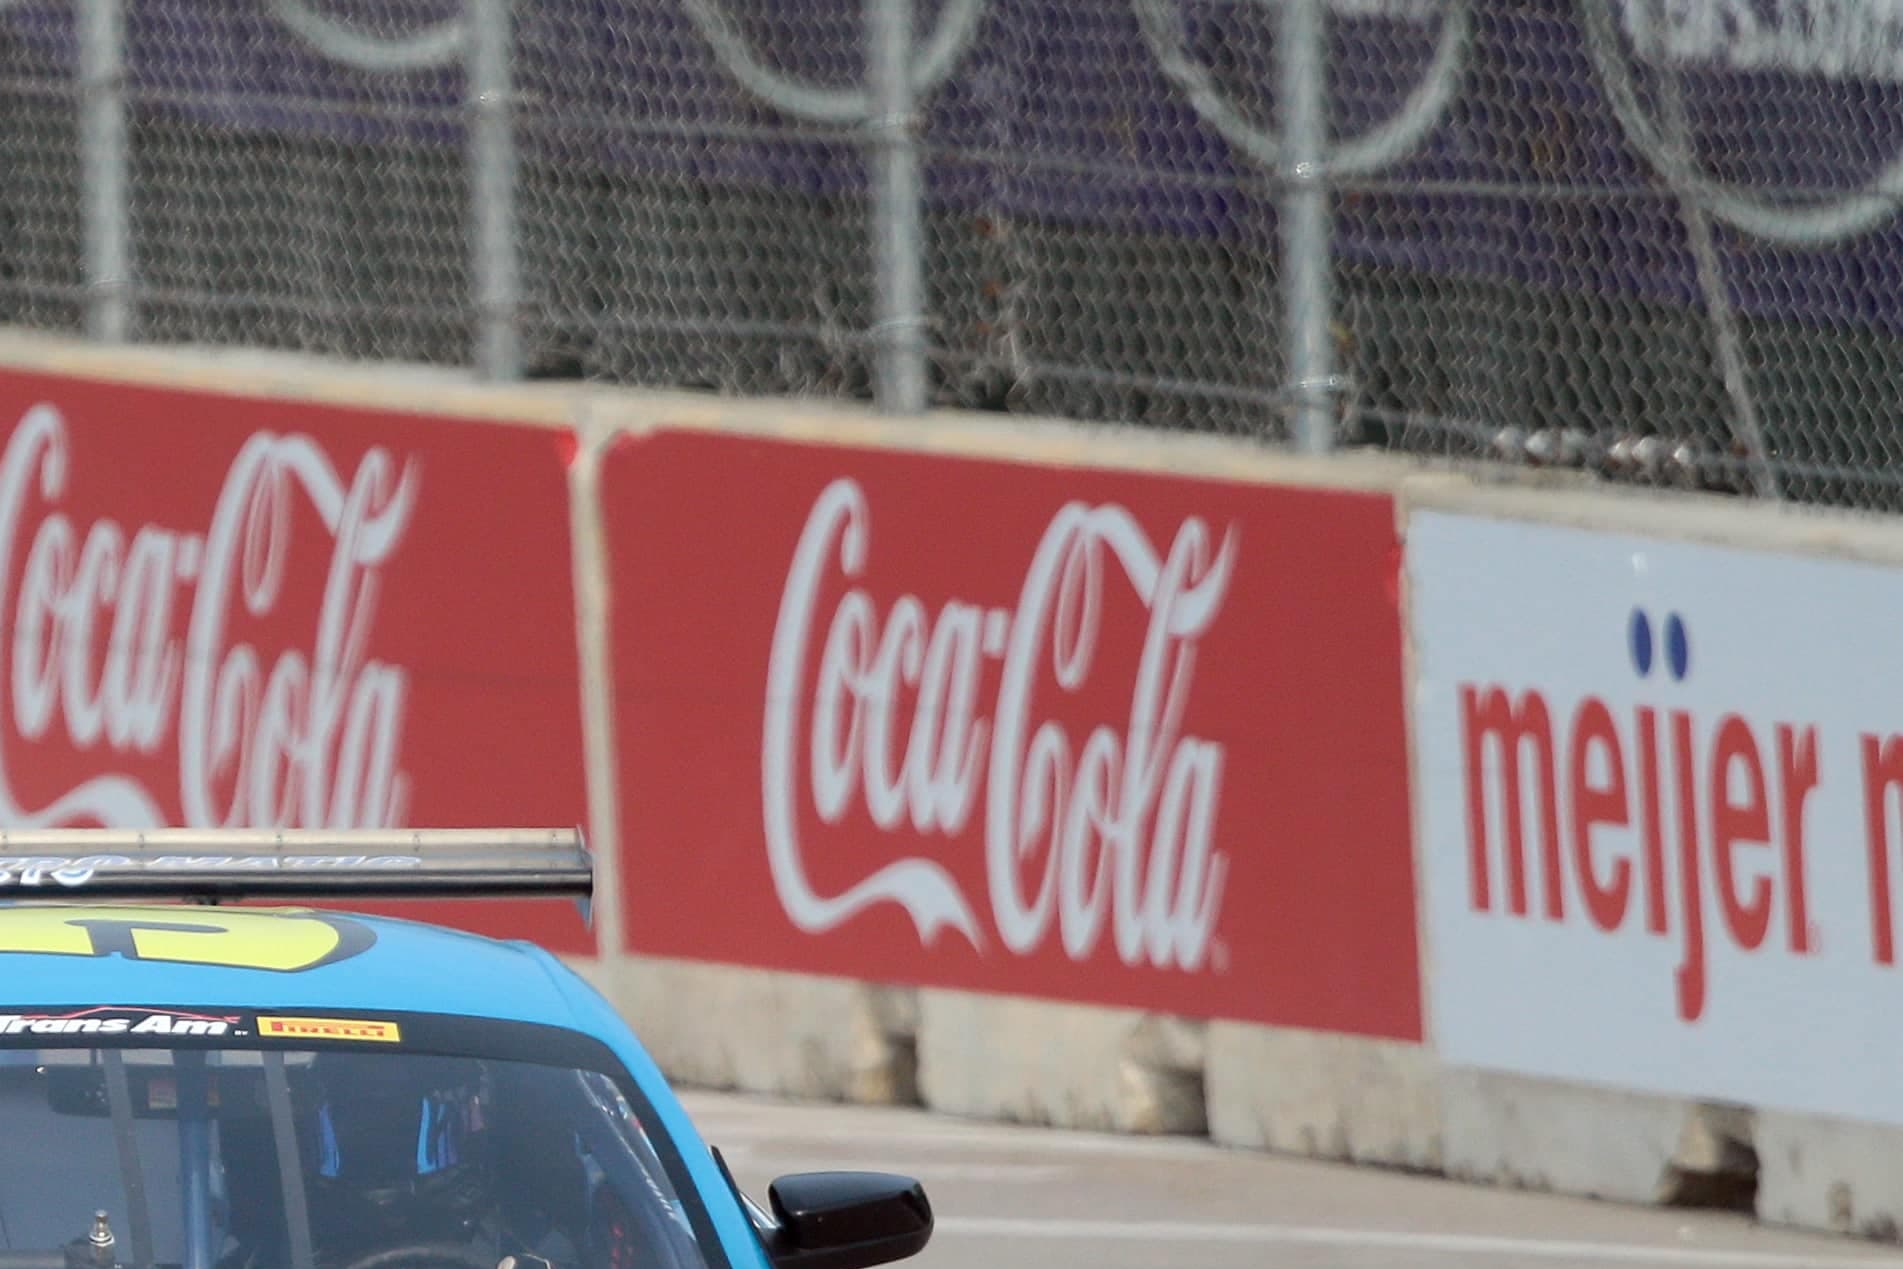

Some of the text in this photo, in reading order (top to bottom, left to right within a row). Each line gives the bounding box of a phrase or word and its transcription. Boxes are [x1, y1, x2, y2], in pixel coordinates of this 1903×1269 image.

[760, 474, 1240, 972] Coca-Cola
[1457, 605, 1821, 1023] meijer
[130, 1015, 229, 1036] Am
